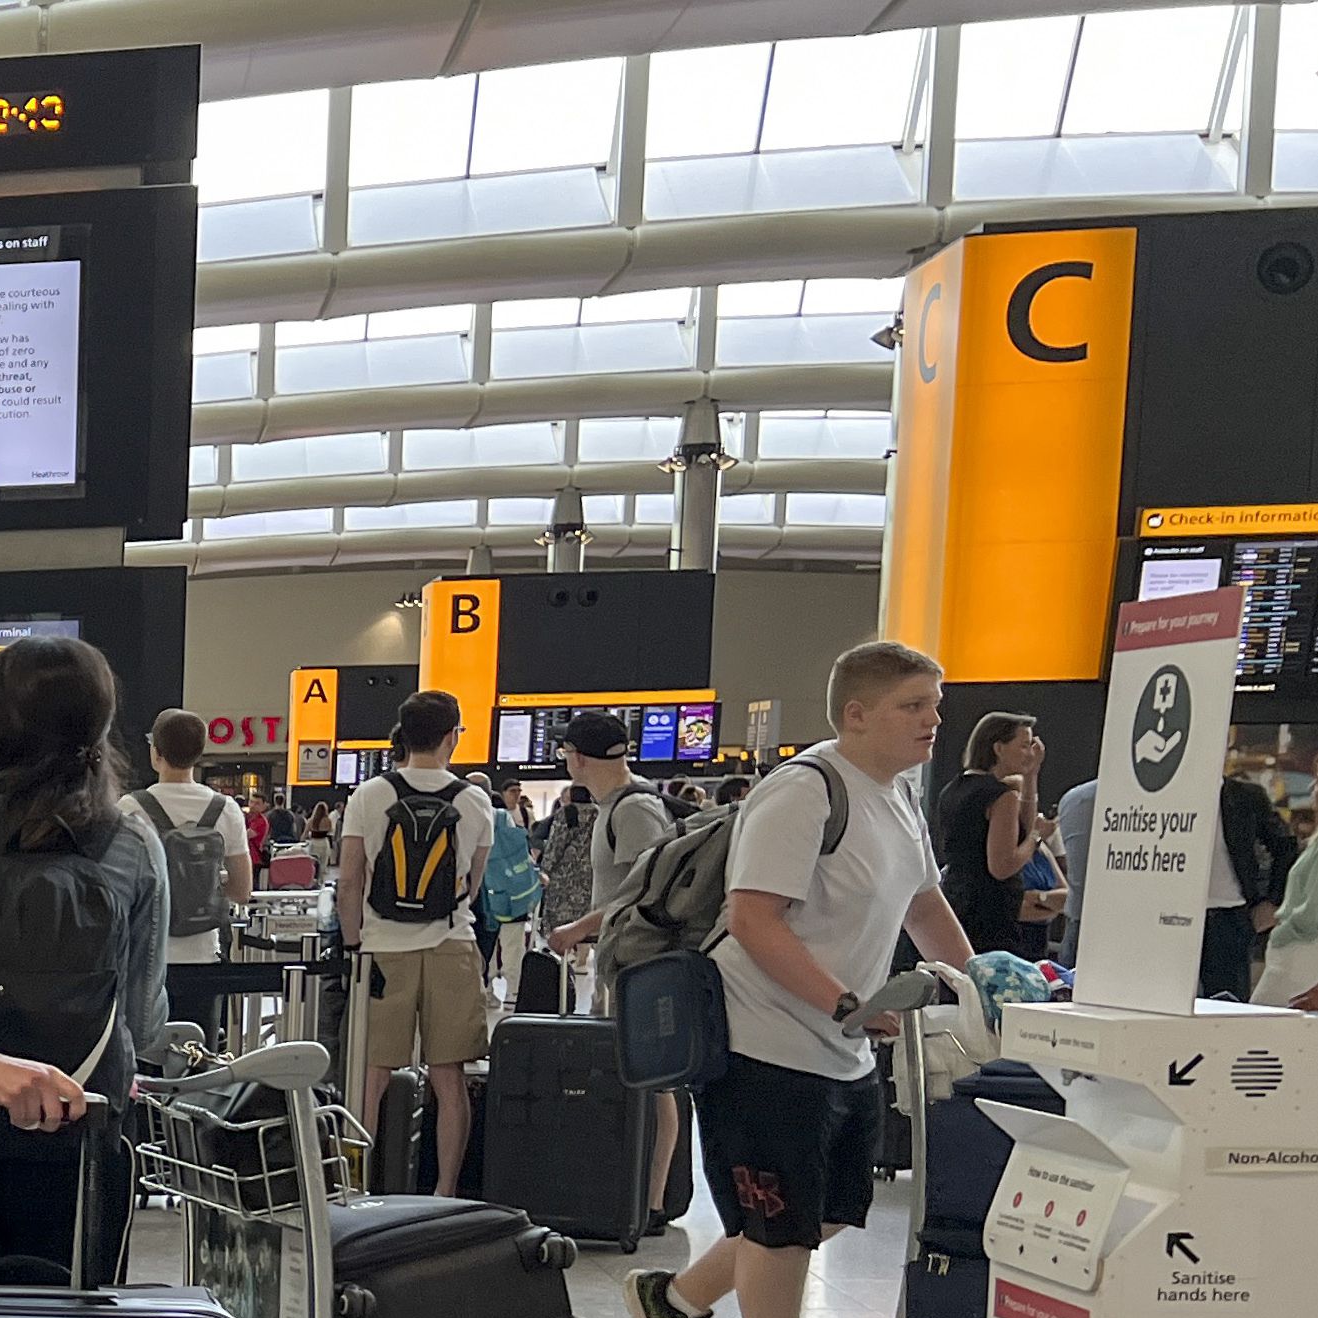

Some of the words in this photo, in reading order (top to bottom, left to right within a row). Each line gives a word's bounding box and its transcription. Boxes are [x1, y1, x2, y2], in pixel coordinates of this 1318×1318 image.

[5, 240, 21, 249] on
[22, 236, 49, 248] staff
[7, 287, 61, 298] courteous
[30, 299, 55, 310] with
[1006, 261, 1094, 363] C
[11, 333, 30, 344] has
[918, 282, 942, 384] C
[12, 346, 35, 356] zero
[7, 359, 28, 369] and
[30, 359, 49, 369] any
[24, 385, 37, 394] or
[1, 396, 30, 407] could
[32, 395, 62, 405] result
[31, 469, 70, 479] Heathrow
[1168, 511, 1235, 526] Check-in
[451, 594, 480, 634] B
[1128, 620, 1157, 636] Prepare
[1158, 618, 1169, 629] for
[1170, 614, 1187, 631] your
[1188, 611, 1220, 631] journey
[303, 678, 328, 703] A
[208, 716, 289, 747] OST
[1103, 805, 1158, 832] Sanitise
[1159, 811, 1198, 840] your
[1106, 844, 1149, 871] hands
[1151, 845, 1186, 872] here
[1171, 1271, 1236, 1285] Sanitise
[1157, 1287, 1207, 1302] hands
[1211, 1287, 1251, 1302] here
[1004, 1295, 1026, 1313] Prepare
